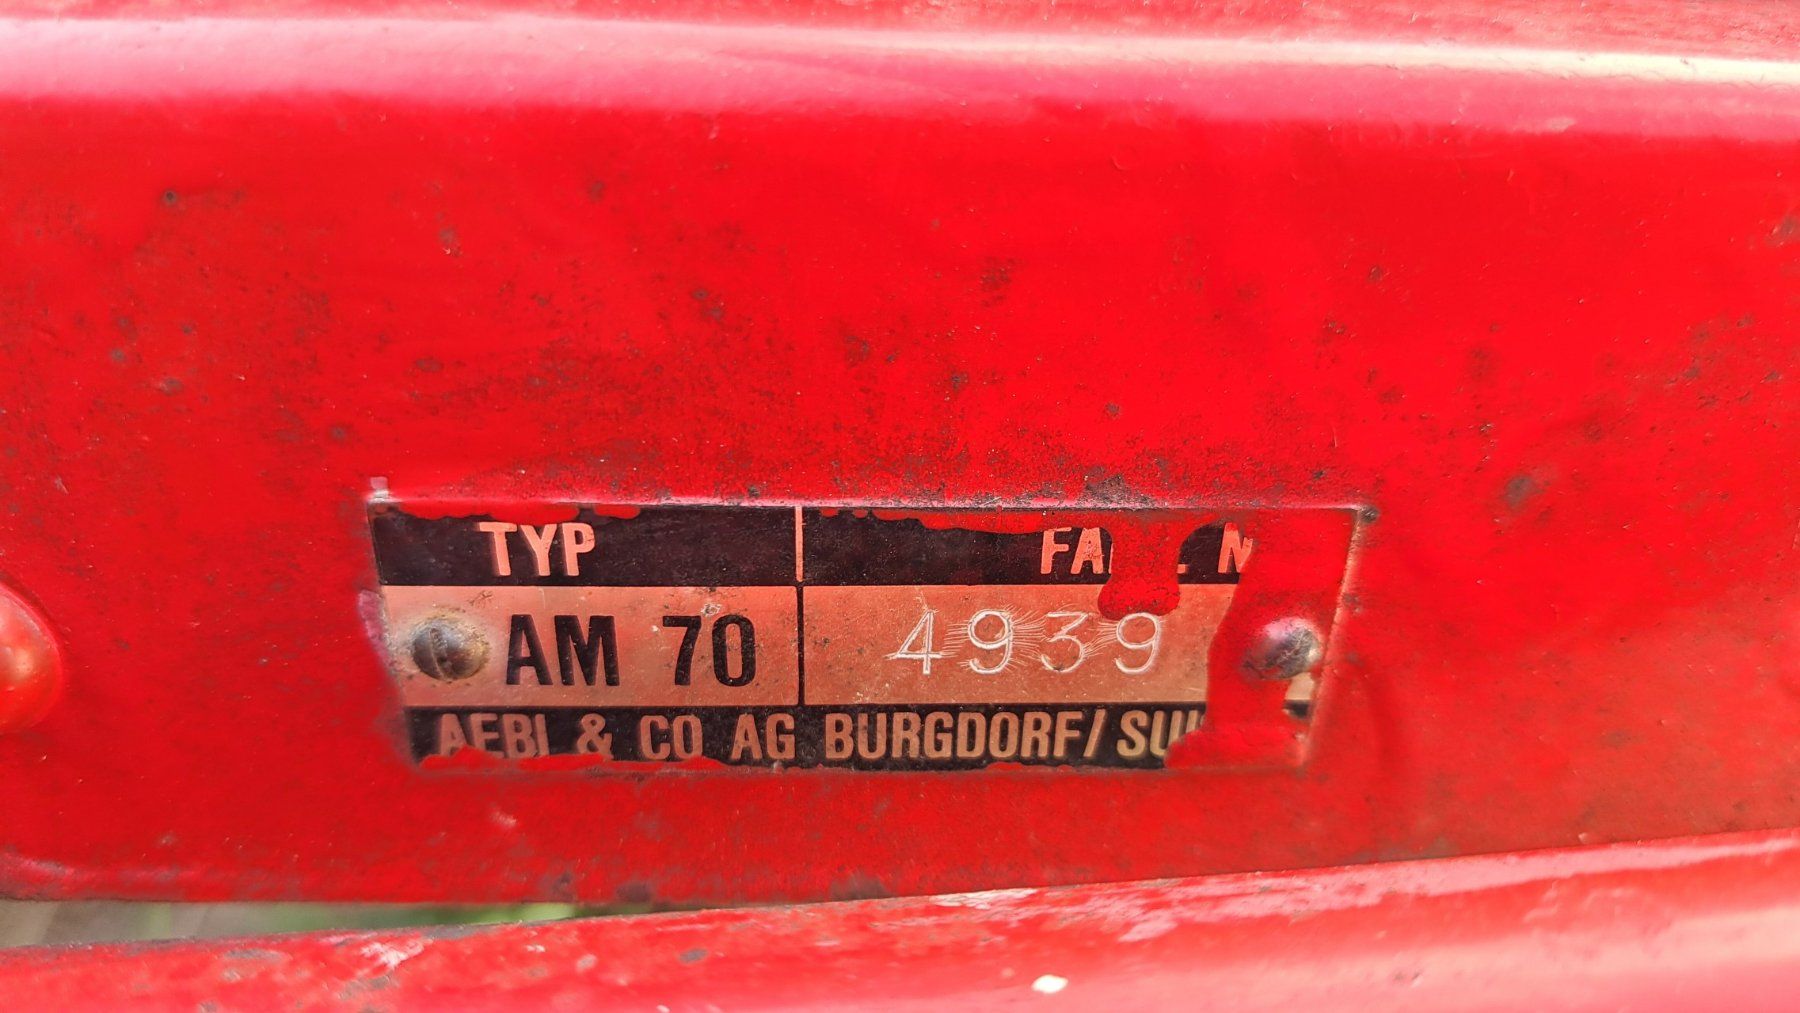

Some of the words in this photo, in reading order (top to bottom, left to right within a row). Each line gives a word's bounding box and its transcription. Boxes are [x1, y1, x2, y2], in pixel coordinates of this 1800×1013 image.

[478, 522, 596, 577] TYP
[1218, 523, 1254, 574] N
[505, 614, 620, 687] AM
[662, 615, 757, 687] 70
[892, 610, 1161, 675] 4939
[438, 713, 550, 759] AEBI
[576, 713, 613, 760] &
[640, 714, 704, 760] CO
[730, 713, 795, 760] AG
[824, 710, 1106, 760] BURGDORF/
